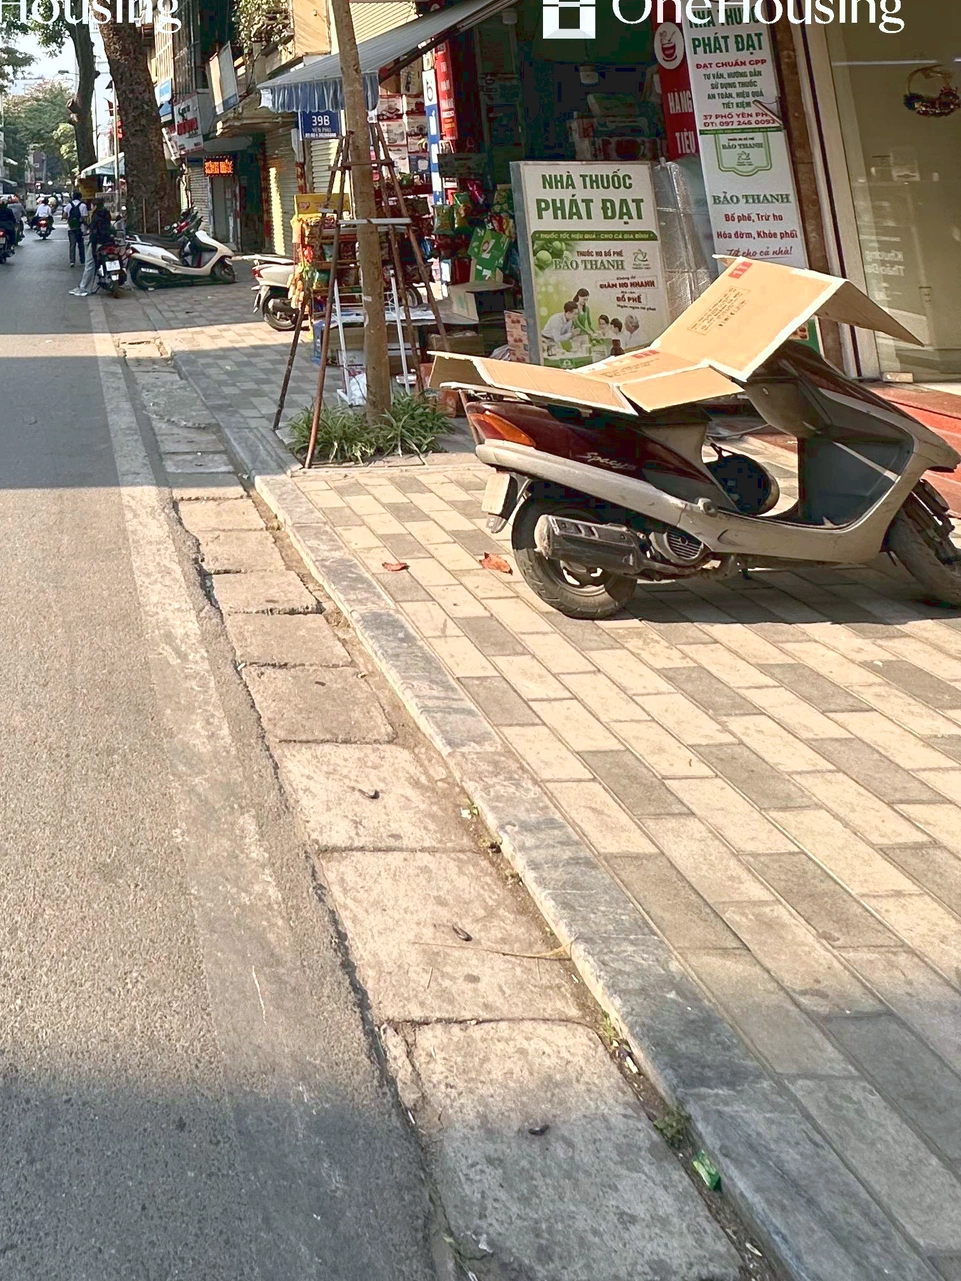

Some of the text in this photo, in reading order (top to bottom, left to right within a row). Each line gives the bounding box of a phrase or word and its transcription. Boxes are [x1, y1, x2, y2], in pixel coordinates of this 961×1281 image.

[692, 32, 763, 55] PHÁT ĐẠT
[696, 58, 767, 70] ĐẠT CHUẨN GPP
[712, 70, 726, 80] VẤN,
[738, 79, 758, 88] THUỐC
[707, 91, 716, 100] AN
[717, 89, 735, 100] TOÀN,
[667, 88, 693, 115] HÀNG
[722, 100, 735, 109] TIẾT
[311, 115, 331, 126] 39B
[715, 112, 733, 120] PHỐ
[735, 110, 753, 118] YÊN
[754, 118, 776, 126] 0093
[675, 129, 697, 154] TIÊU
[737, 142, 764, 150] THANH
[541, 169, 633, 190] NHÀ THUỐC
[712, 191, 792, 205] BẢO THANH
[536, 194, 645, 225] PHÁT ĐẠT
[756, 212, 783, 221] Trừ ho
[716, 230, 733, 239] Hóa
[733, 230, 756, 240] đờm,
[553, 258, 579, 270] BẢO
[580, 260, 626, 270] THANH
[629, 280, 656, 288] NHANH
